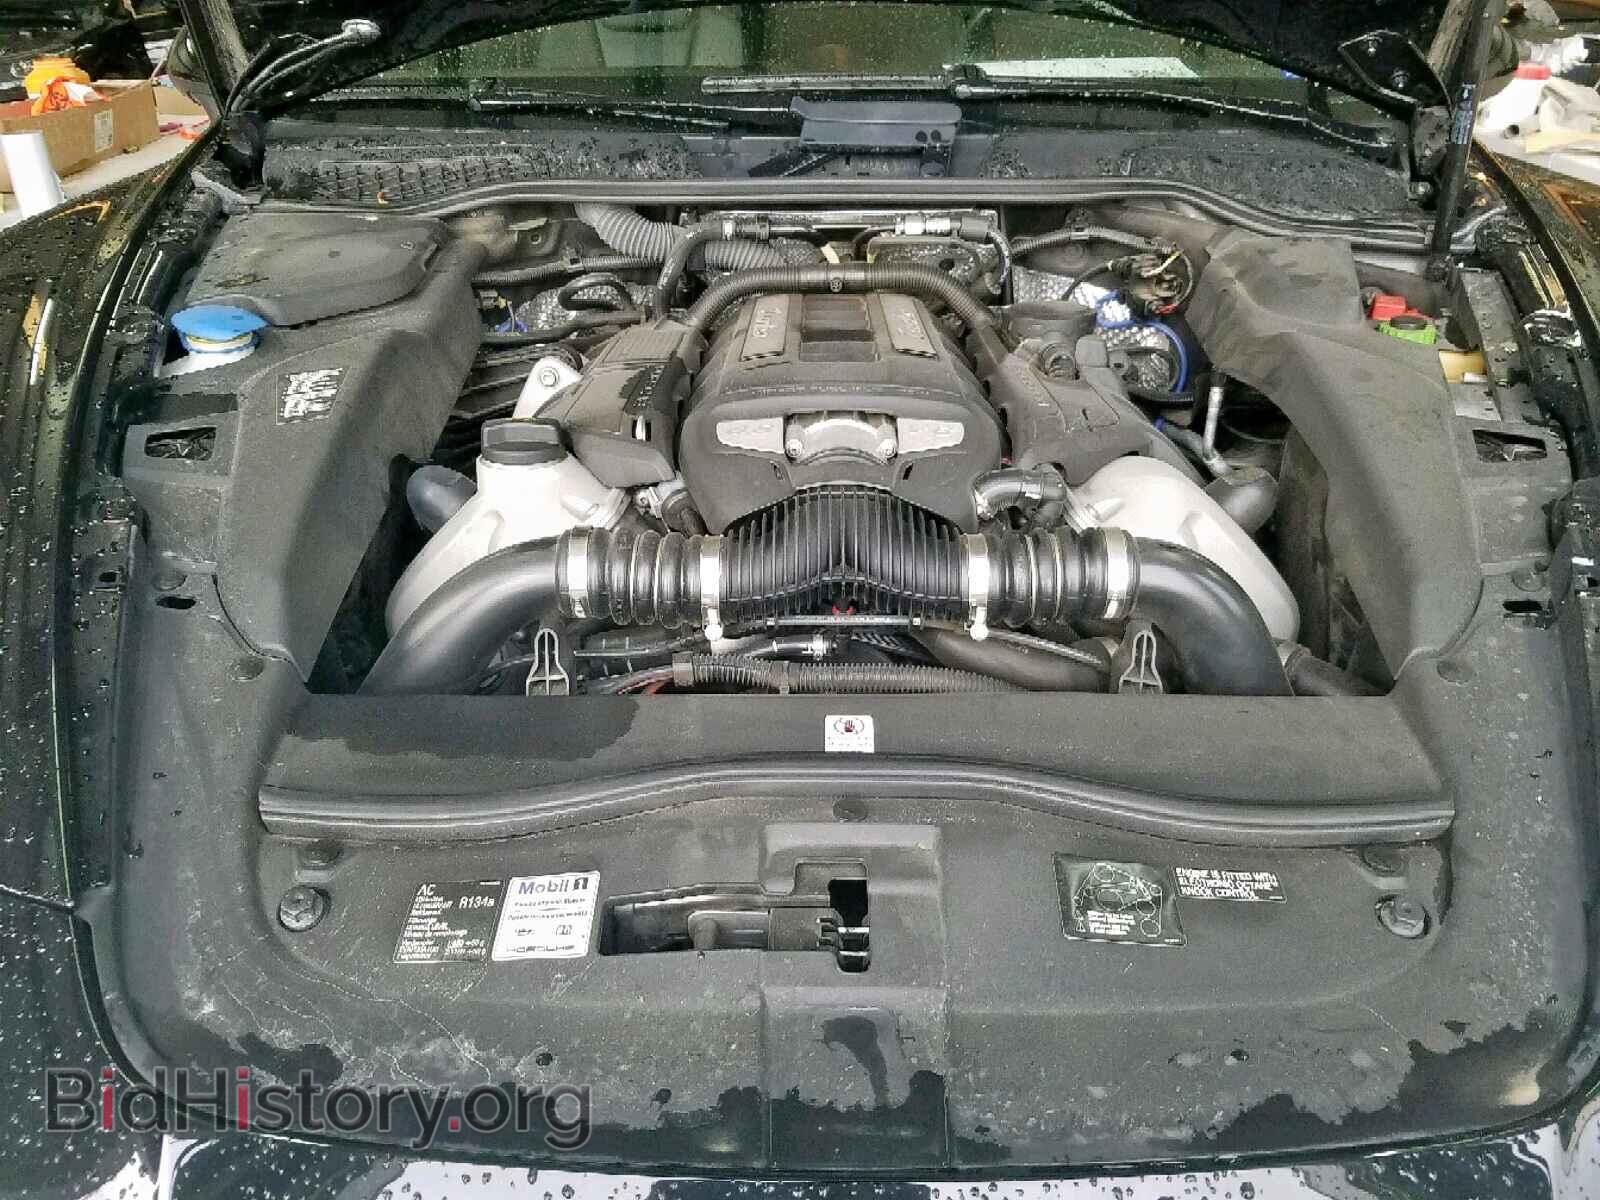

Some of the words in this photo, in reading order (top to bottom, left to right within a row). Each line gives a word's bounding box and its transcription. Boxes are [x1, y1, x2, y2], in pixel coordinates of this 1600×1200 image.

[417, 884, 436, 896] AC
[518, 879, 570, 895] Mobil
[458, 896, 495, 909] R134a
